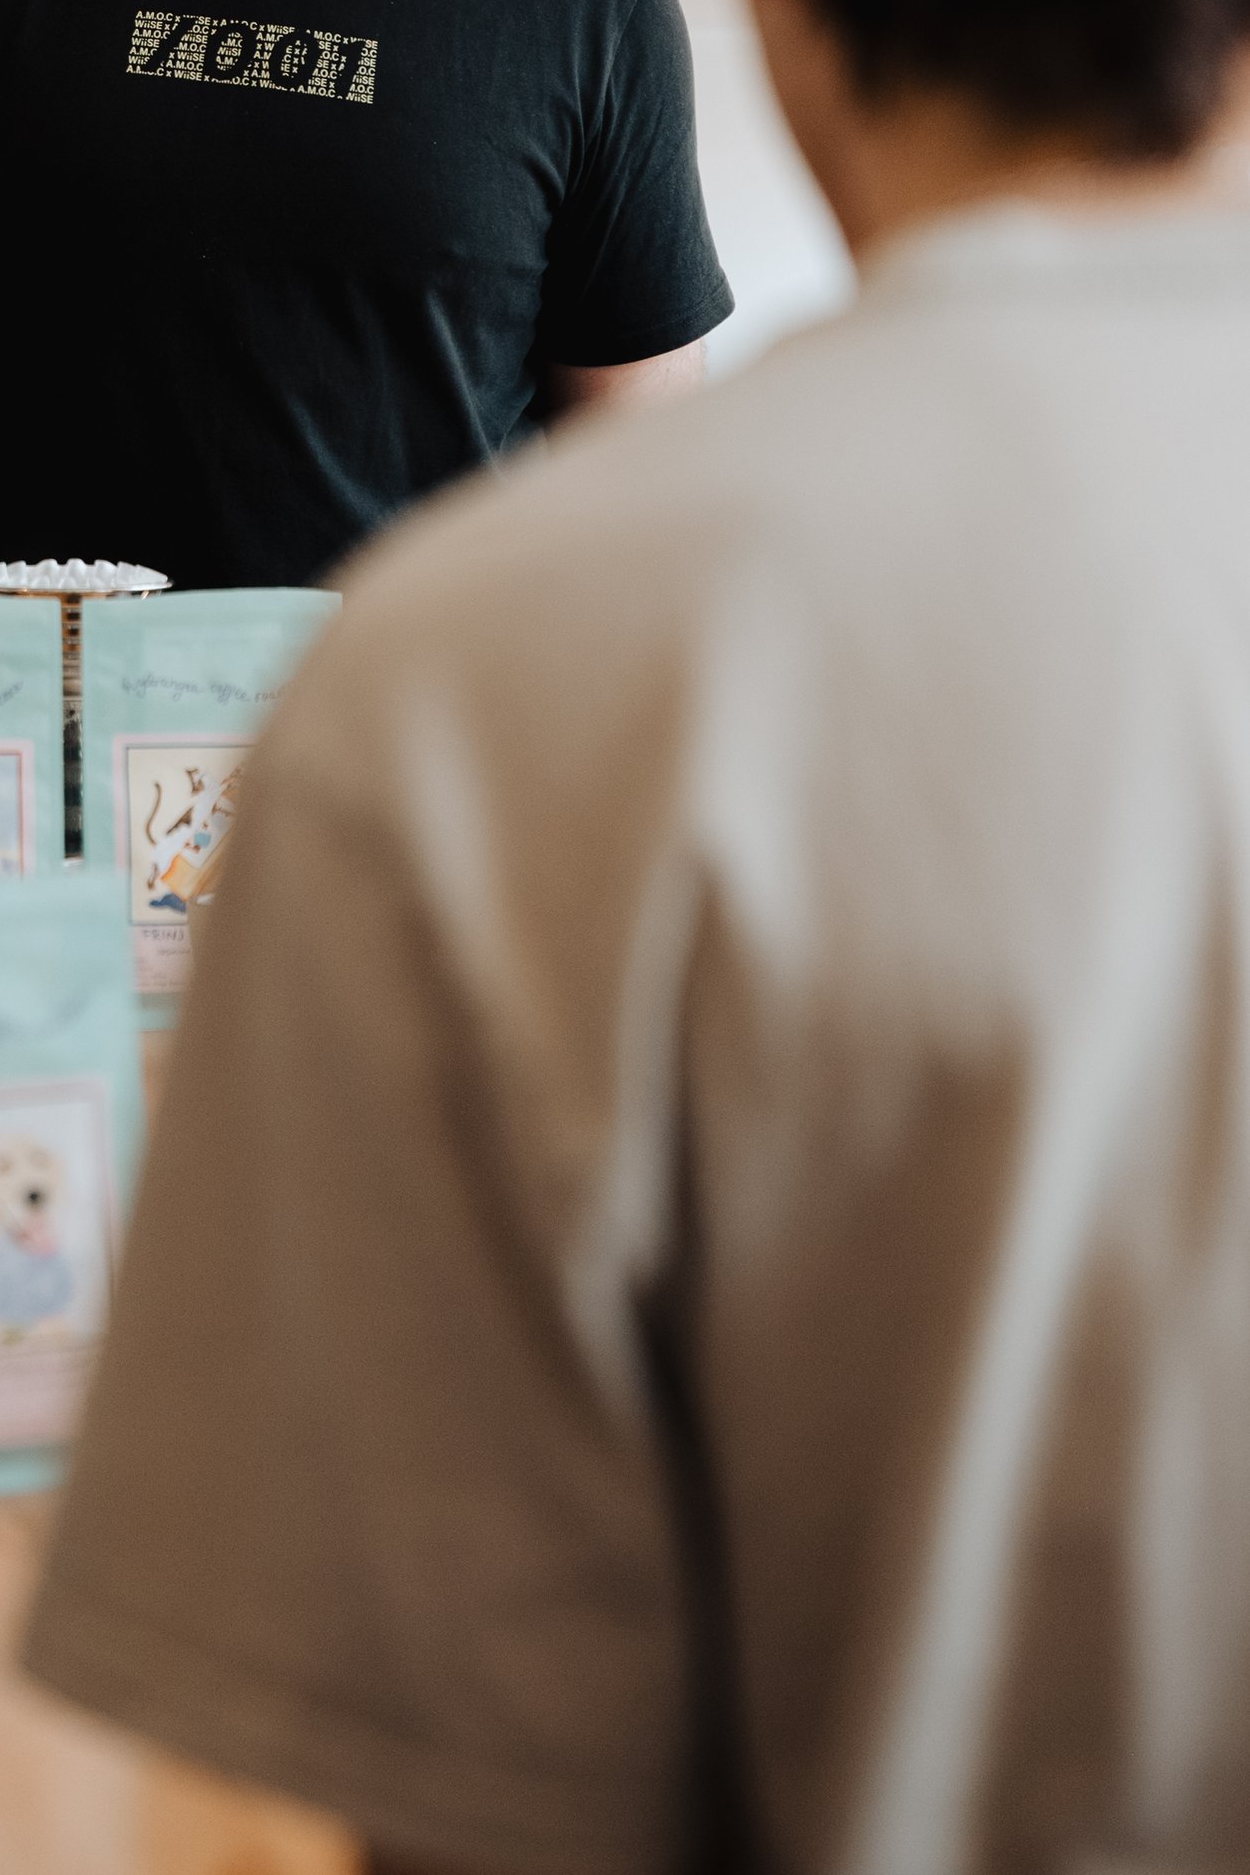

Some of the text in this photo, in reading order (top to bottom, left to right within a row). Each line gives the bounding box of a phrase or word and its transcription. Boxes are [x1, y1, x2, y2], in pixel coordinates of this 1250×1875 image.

[134, 19, 163, 30] WiiSE
[164, 23, 171, 31] x
[332, 44, 339, 52] x
[135, 11, 174, 22] A.M.O.C
[174, 15, 181, 23] x
[212, 19, 219, 27] x
[258, 24, 266, 32] x
[342, 36, 349, 44] x
[131, 36, 161, 48] WiiSE
[292, 57, 300, 65] x
[330, 63, 338, 71] x
[168, 51, 175, 59] x
[176, 50, 206, 63] WiiSE
[253, 61, 261, 69] x
[291, 66, 298, 74] x
[256, 42, 263, 50] x
[293, 48, 301, 56] x
[340, 55, 347, 63] x
[165, 59, 205, 72] A.M.O.C
[242, 69, 250, 77] x
[328, 81, 336, 89] x
[165, 70, 173, 78] x
[173, 69, 203, 82] WiiSE
[203, 74, 211, 82] x
[250, 79, 258, 87] x
[297, 84, 337, 99] A.M.O.C
